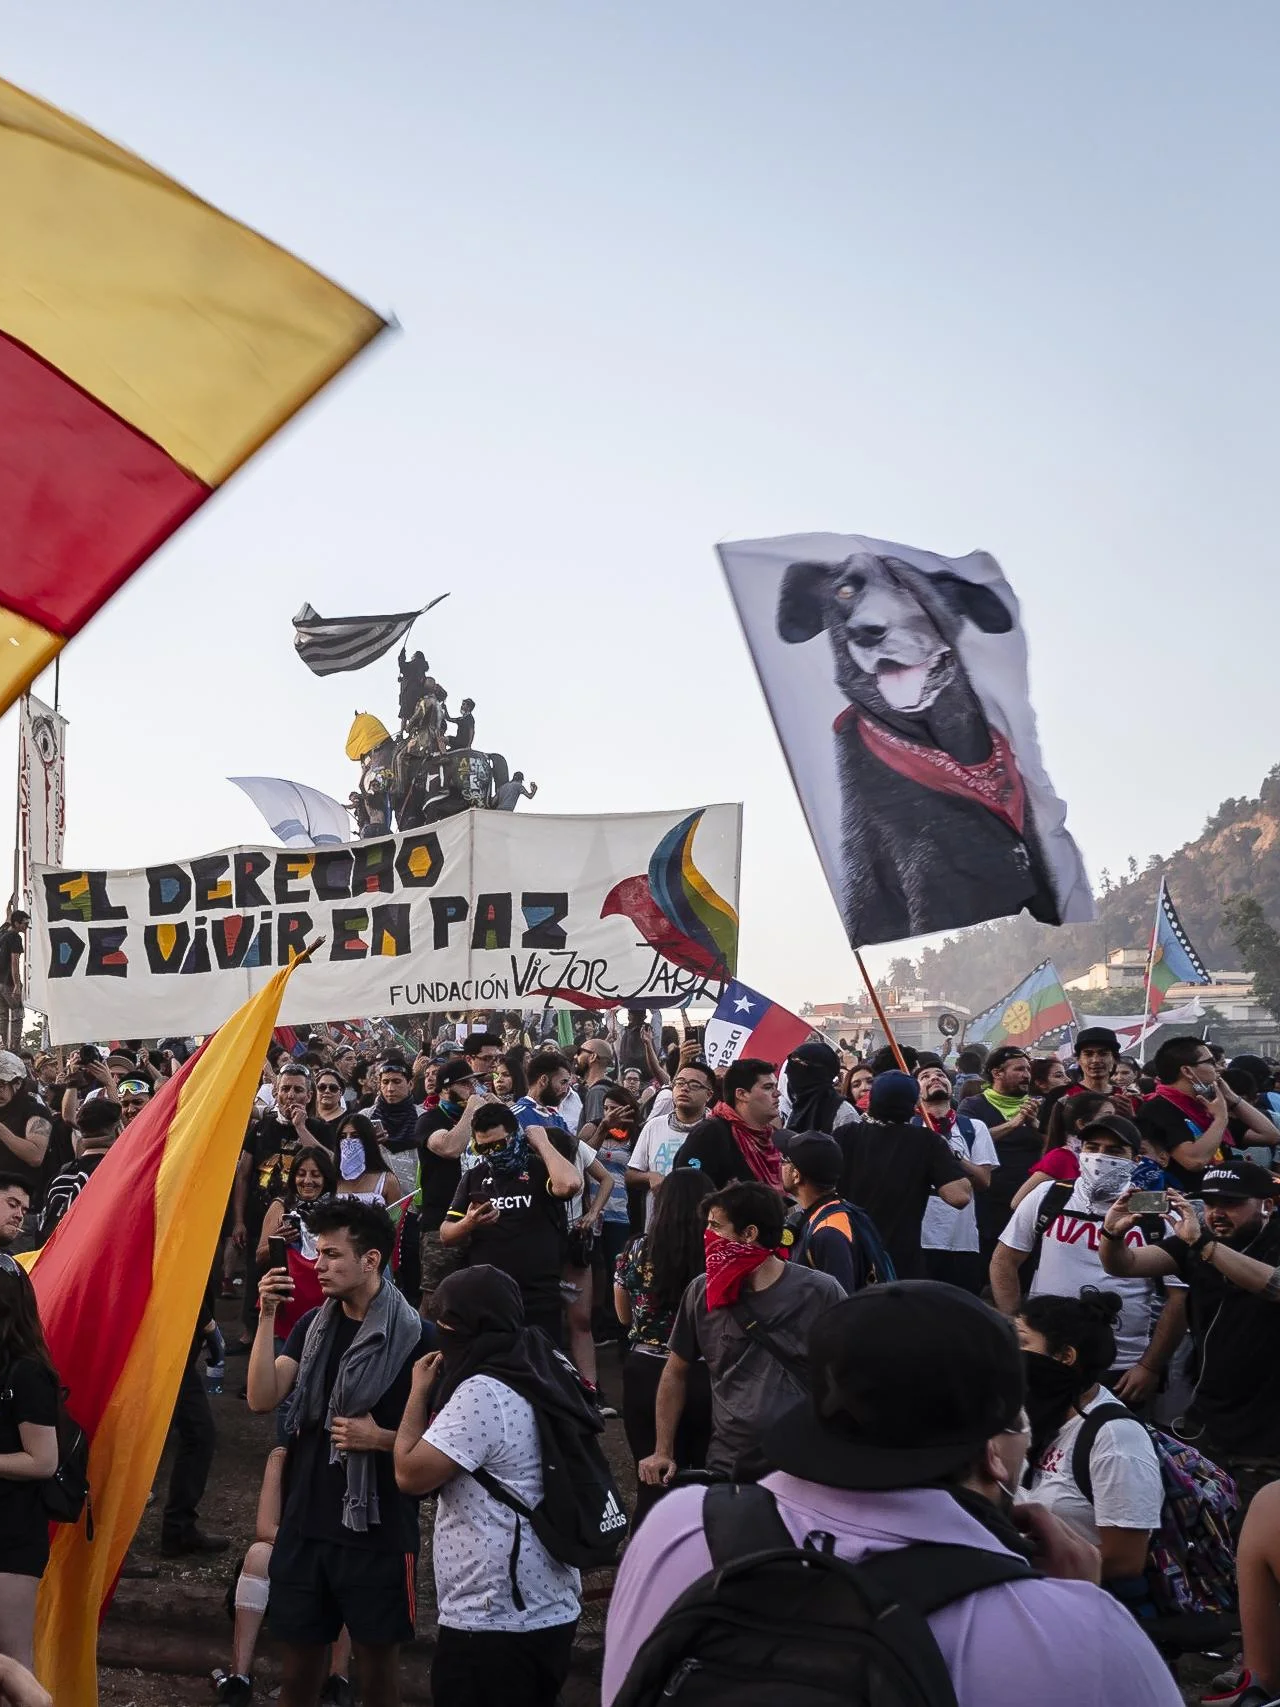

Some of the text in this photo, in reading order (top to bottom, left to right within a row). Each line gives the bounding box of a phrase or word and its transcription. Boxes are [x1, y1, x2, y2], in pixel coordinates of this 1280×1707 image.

[42, 832, 445, 922] EL DERECHO
[47, 925, 129, 979] DE
[329, 903, 411, 962] EN
[429, 892, 569, 951] PAZ
[390, 973, 509, 1006] FUNDACIÓN
[489, 1195, 532, 1210] RECTV
[600, 1513, 627, 1533] adidas
